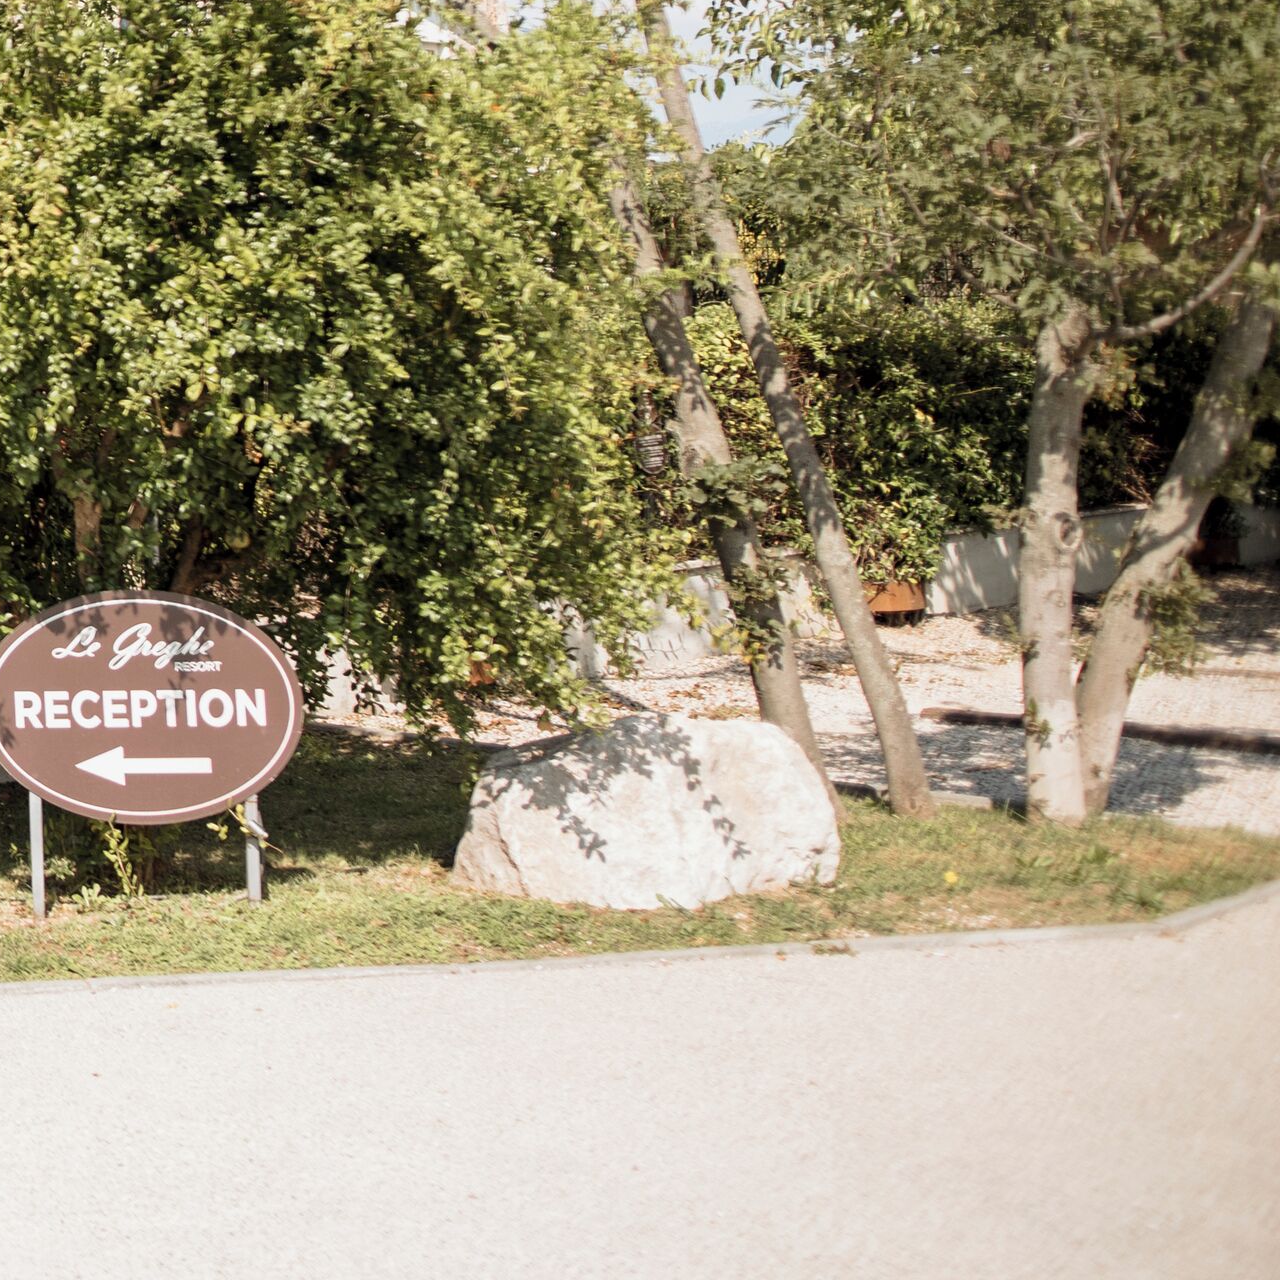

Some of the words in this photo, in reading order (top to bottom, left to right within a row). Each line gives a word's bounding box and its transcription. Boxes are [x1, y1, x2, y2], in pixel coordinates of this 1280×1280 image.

[51, 625, 102, 659] Le
[108, 622, 215, 670] Greghe
[173, 660, 223, 673] RESORT
[13, 688, 268, 729] RECEPTION
